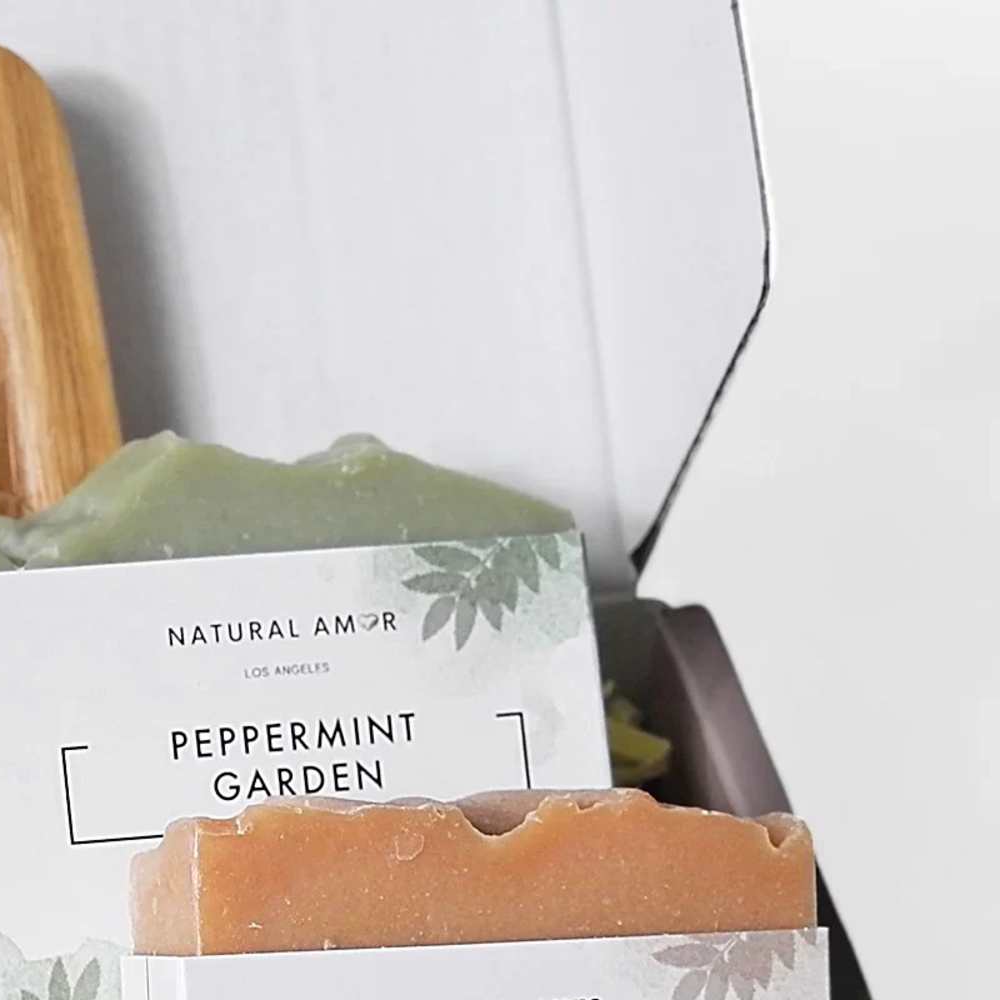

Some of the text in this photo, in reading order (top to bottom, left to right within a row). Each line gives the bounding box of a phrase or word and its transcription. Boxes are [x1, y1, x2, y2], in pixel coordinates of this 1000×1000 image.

[167, 618, 300, 647] NATURAL
[244, 662, 330, 679] LOS ANGELES
[171, 712, 417, 760] PEPPERMINT
[213, 760, 384, 801] GARDEN
